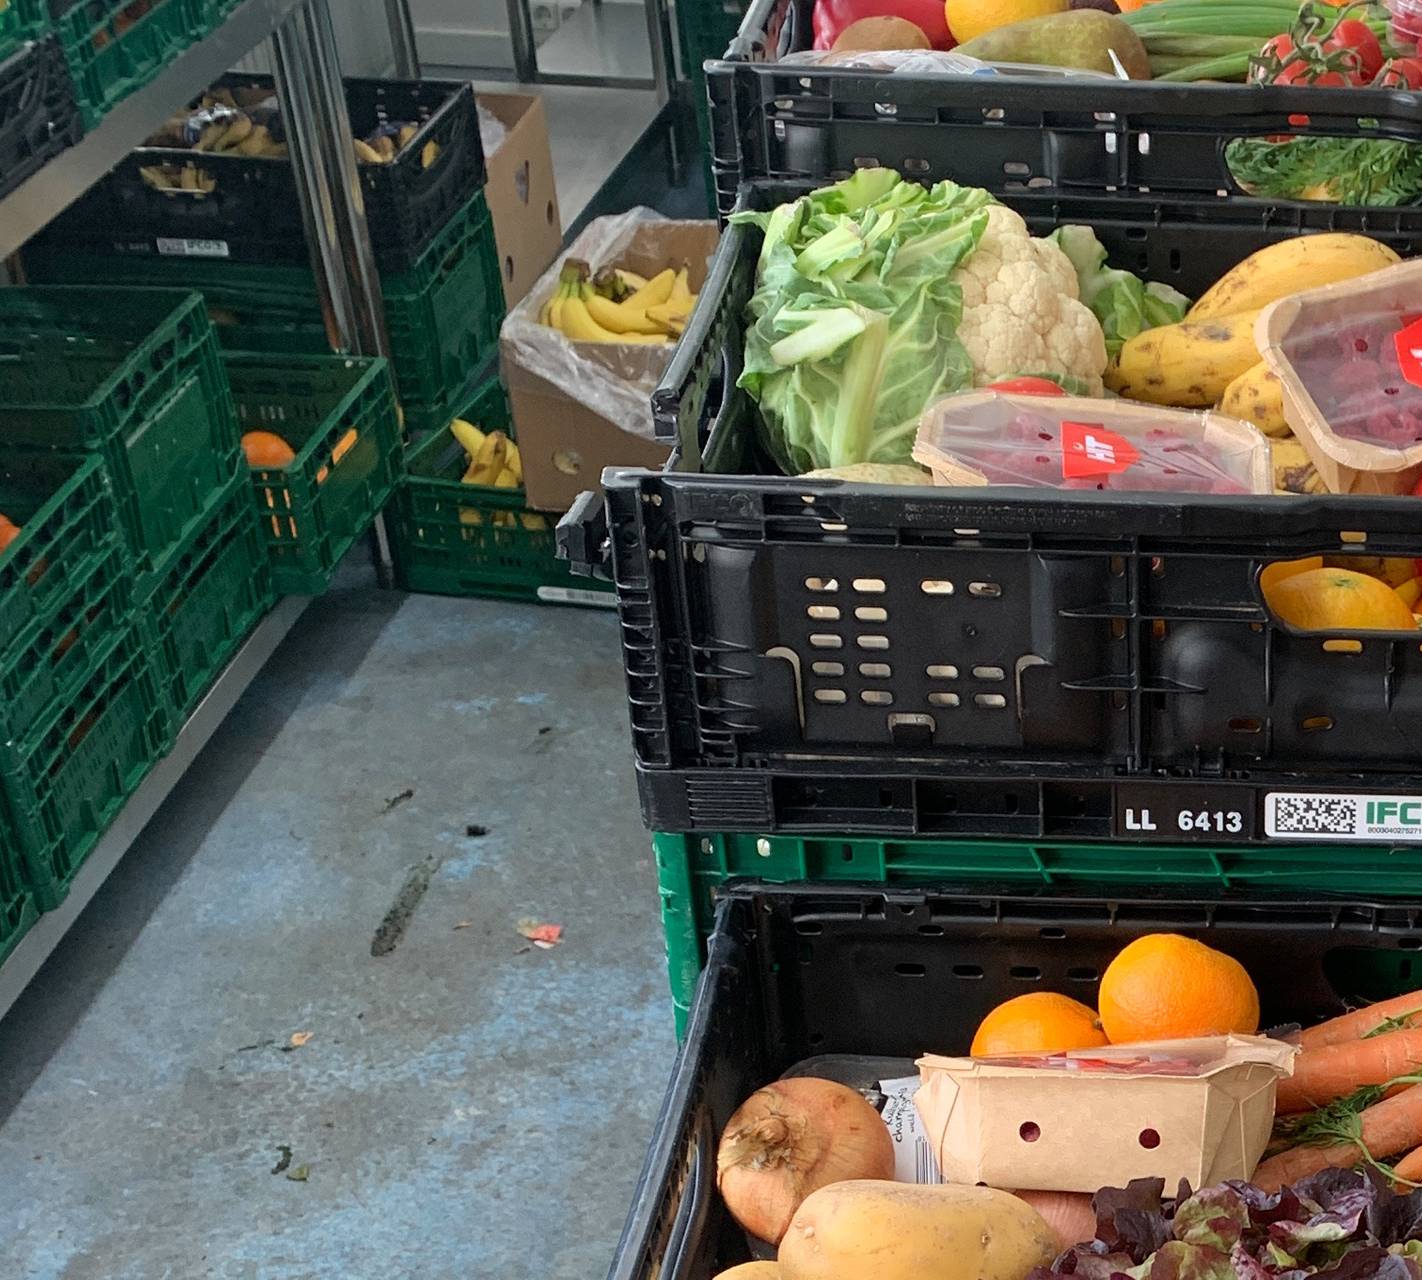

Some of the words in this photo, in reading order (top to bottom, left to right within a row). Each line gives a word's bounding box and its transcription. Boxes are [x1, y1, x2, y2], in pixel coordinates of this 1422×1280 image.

[1072, 434, 1116, 464] HIT
[1125, 808, 1157, 830] LL
[1178, 810, 1243, 833] 6413
